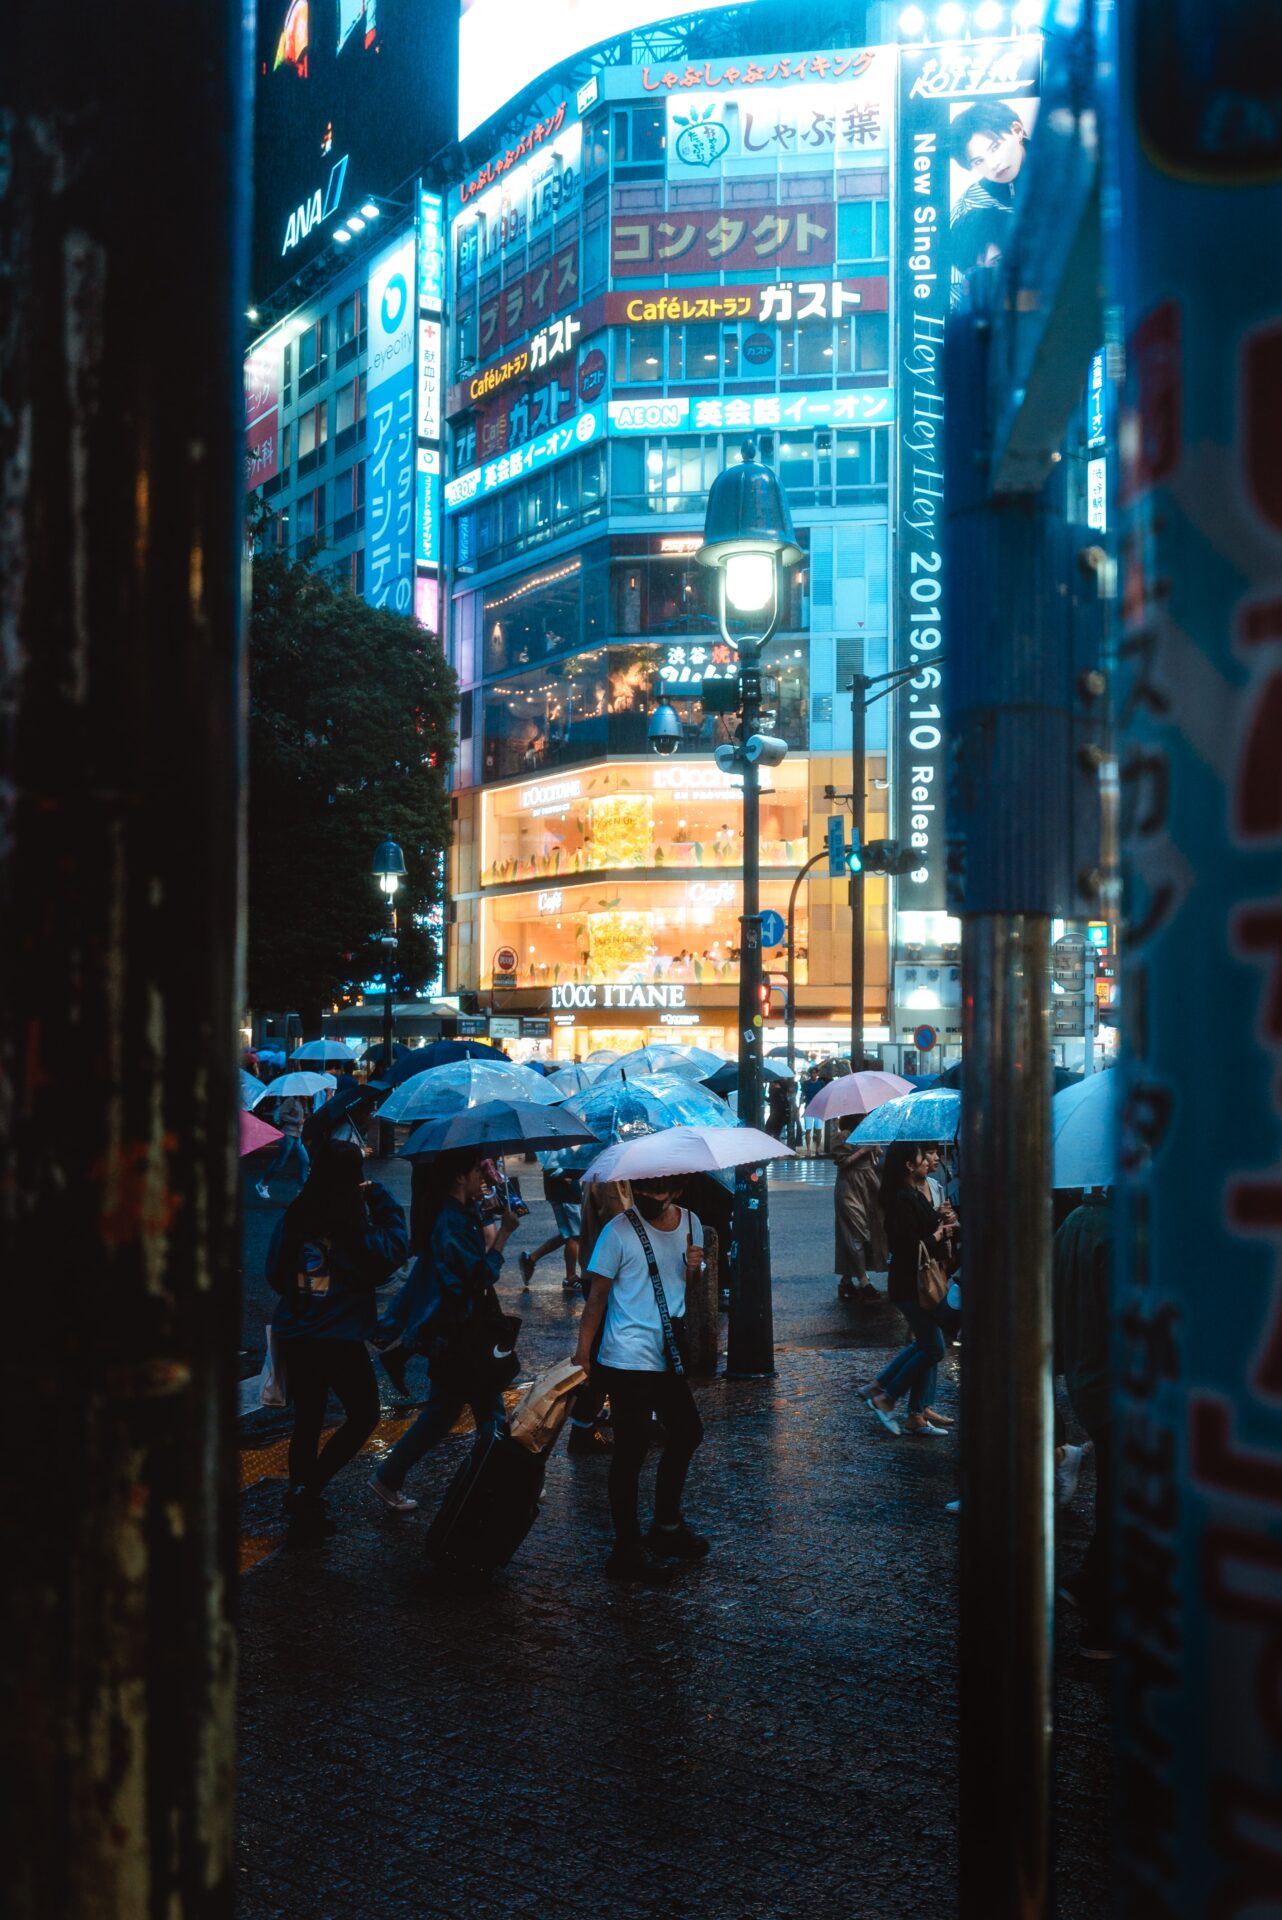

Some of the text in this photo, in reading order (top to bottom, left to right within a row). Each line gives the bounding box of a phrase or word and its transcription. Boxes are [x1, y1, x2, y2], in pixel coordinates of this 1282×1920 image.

[642, 51, 876, 91] しゃぶしゃぶバイキング
[744, 102, 881, 152] しゃぶ葉
[282, 188, 322, 256] ANA
[614, 213, 829, 261] コンタクト
[481, 252, 577, 345] プライス
[759, 282, 861, 322] ガスト
[374, 330, 414, 369] eyecity
[530, 314, 580, 372] ガスト
[424, 349, 436, 423] 献血ルーム
[695, 397, 887, 427] 英会話イーオン
[510, 381, 570, 448] ガスト
[617, 404, 679, 427] AEON
[457, 431, 476, 465] 7F
[484, 429, 573, 490] 英会話イーオン
[396, 388, 412, 610] コンタクトの
[904, 133, 945, 883] New Single Hey Hey Hey 2019.6.10 Releae
[626, 1208, 656, 1264] SUPREM
